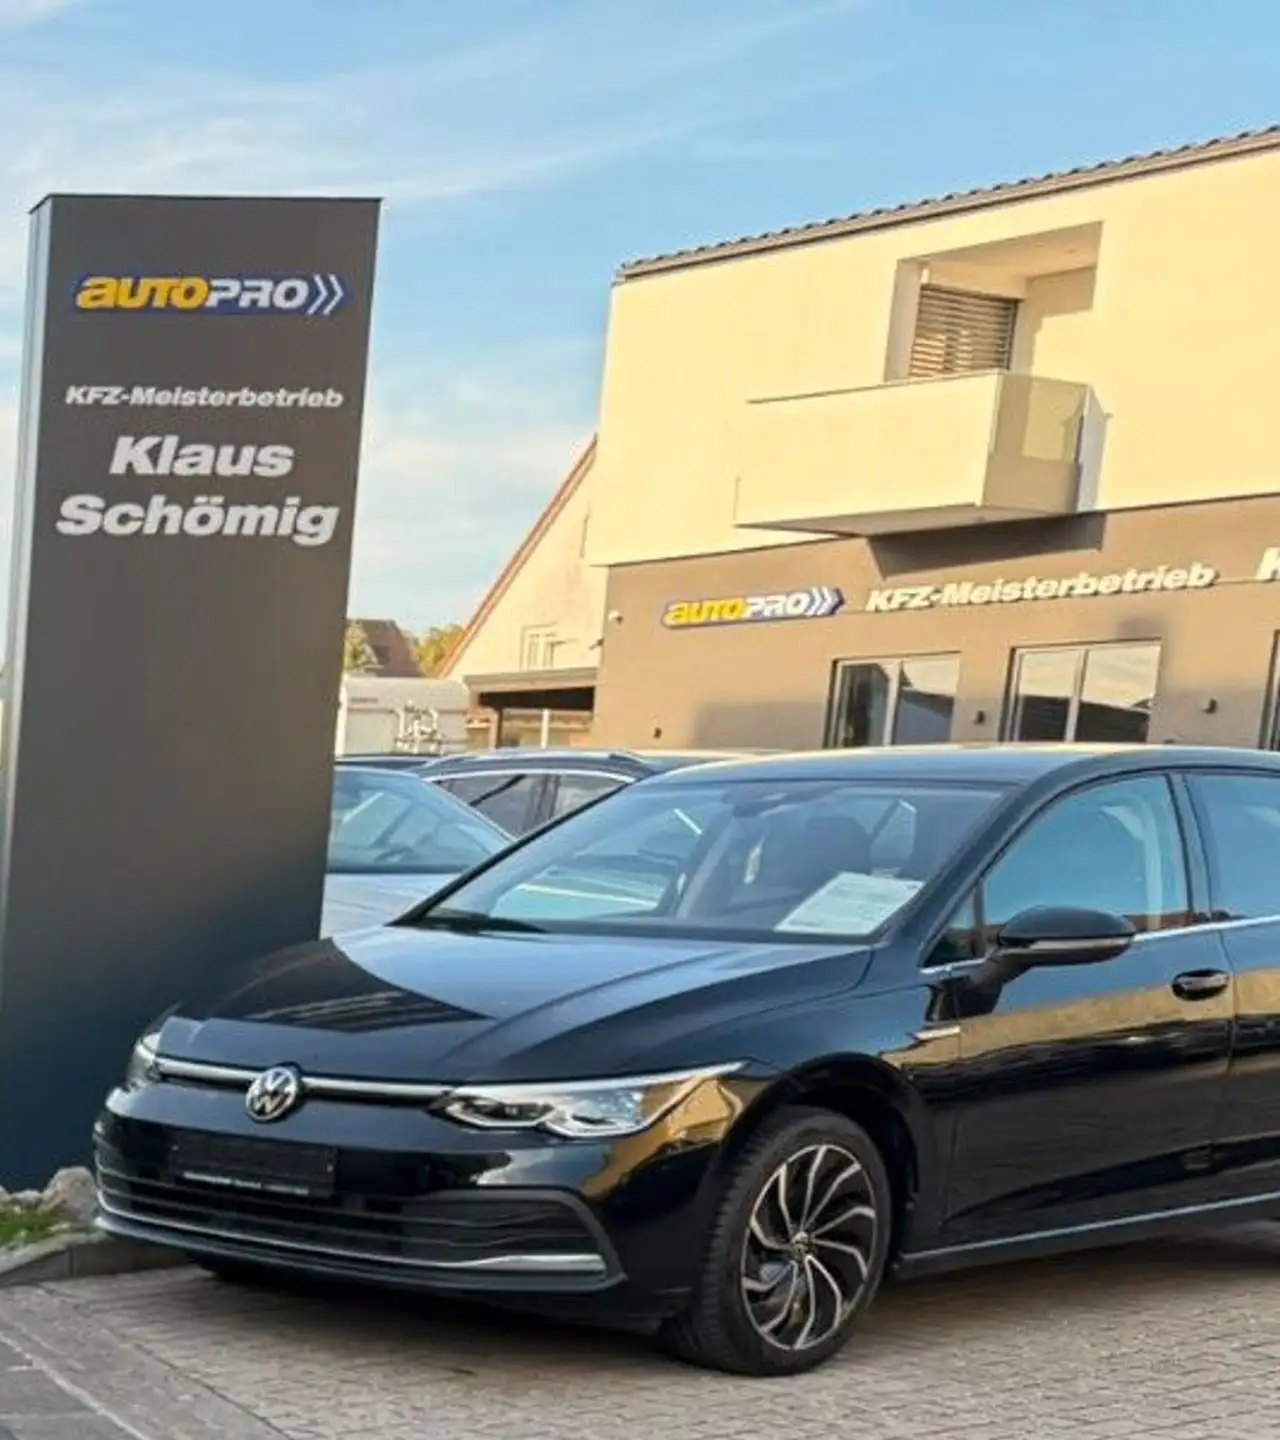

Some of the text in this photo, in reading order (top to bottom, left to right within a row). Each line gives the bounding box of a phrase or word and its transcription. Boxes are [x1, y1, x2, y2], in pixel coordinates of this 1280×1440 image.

[65, 384, 344, 408] KFZ-Meisterbetrieb
[108, 434, 295, 477] Klaus
[55, 493, 340, 546] Schömig
[864, 562, 1218, 613] KFZ-Meisterbetrieb
